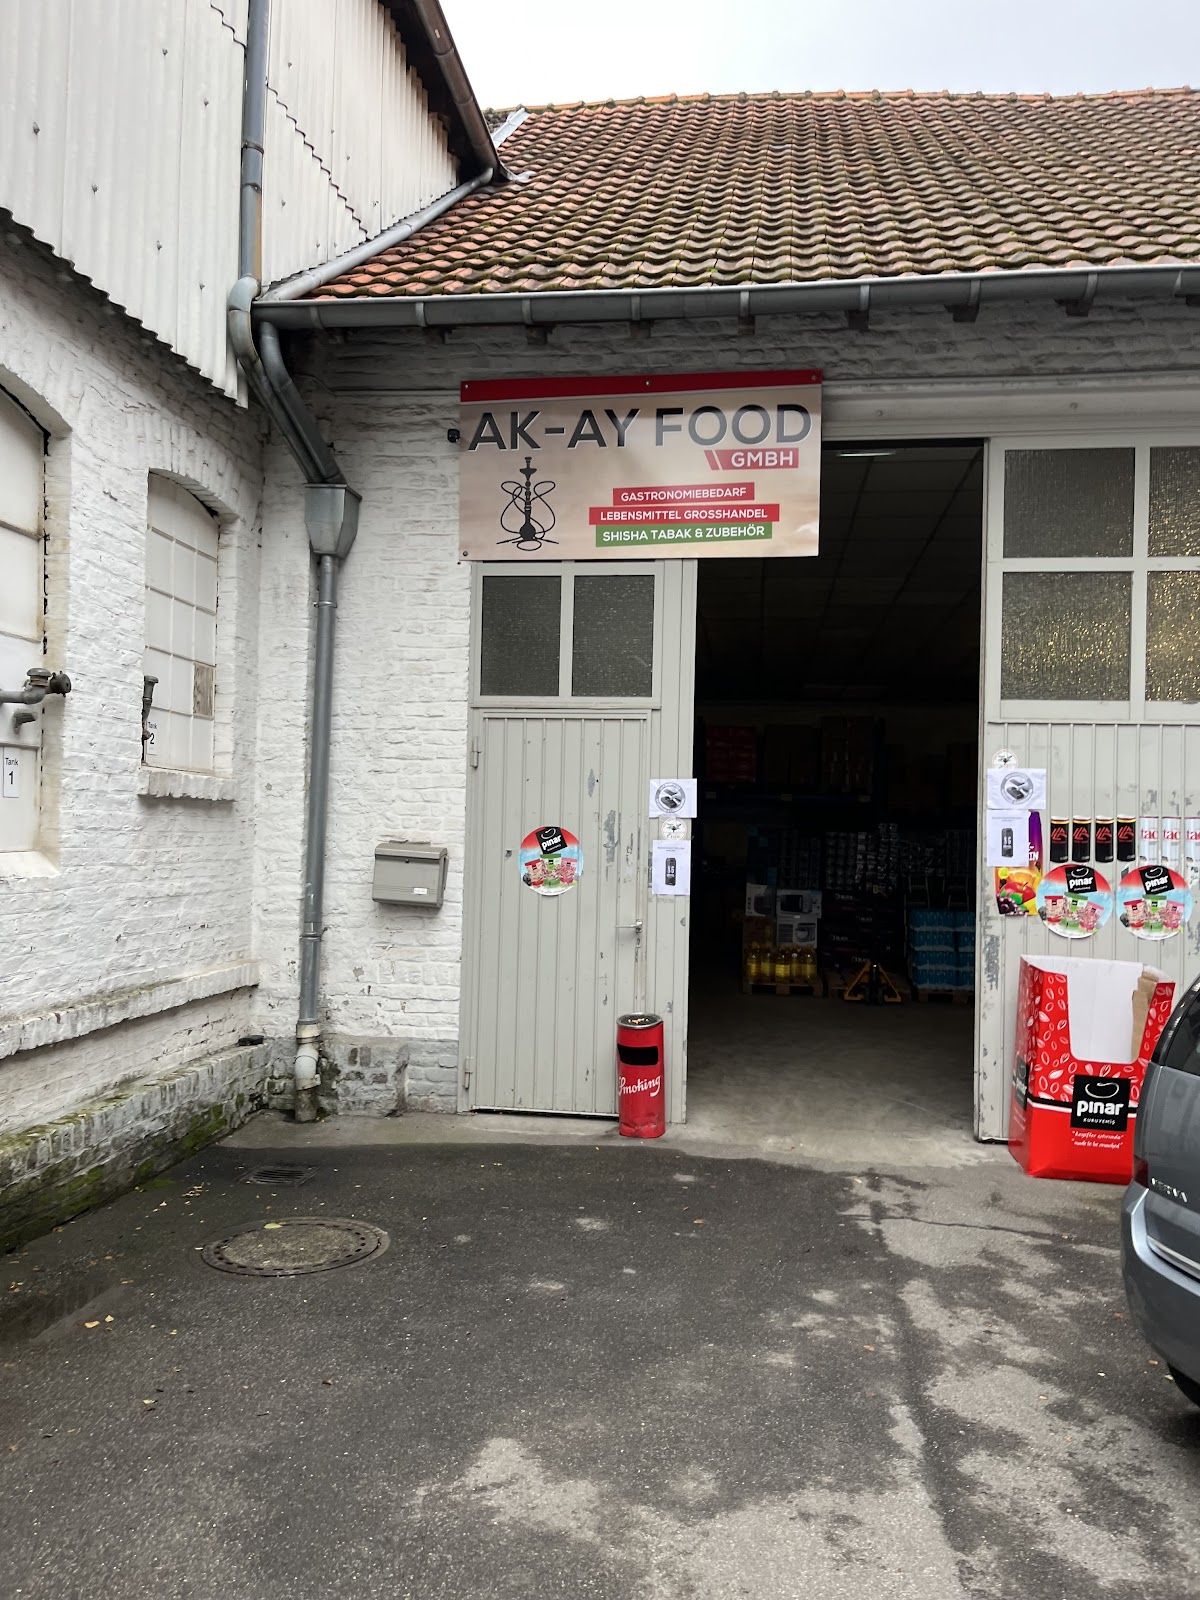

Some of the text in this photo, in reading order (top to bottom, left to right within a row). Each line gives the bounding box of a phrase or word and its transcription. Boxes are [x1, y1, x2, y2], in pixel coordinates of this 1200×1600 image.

[468, 403, 813, 451] AK-AY FOOD
[730, 450, 794, 468] GMBH
[621, 487, 747, 502] GASTRONOMIEBEDARF
[600, 508, 768, 521] LEBENSMITTEL GROSSHANDEL
[602, 524, 765, 542] SHISHA TABAK & ZUBEHÖR
[149, 732, 155, 745] 2
[5, 757, 19, 766] Tank
[8, 771, 14, 785] 1
[619, 1075, 661, 1097] Smoking
